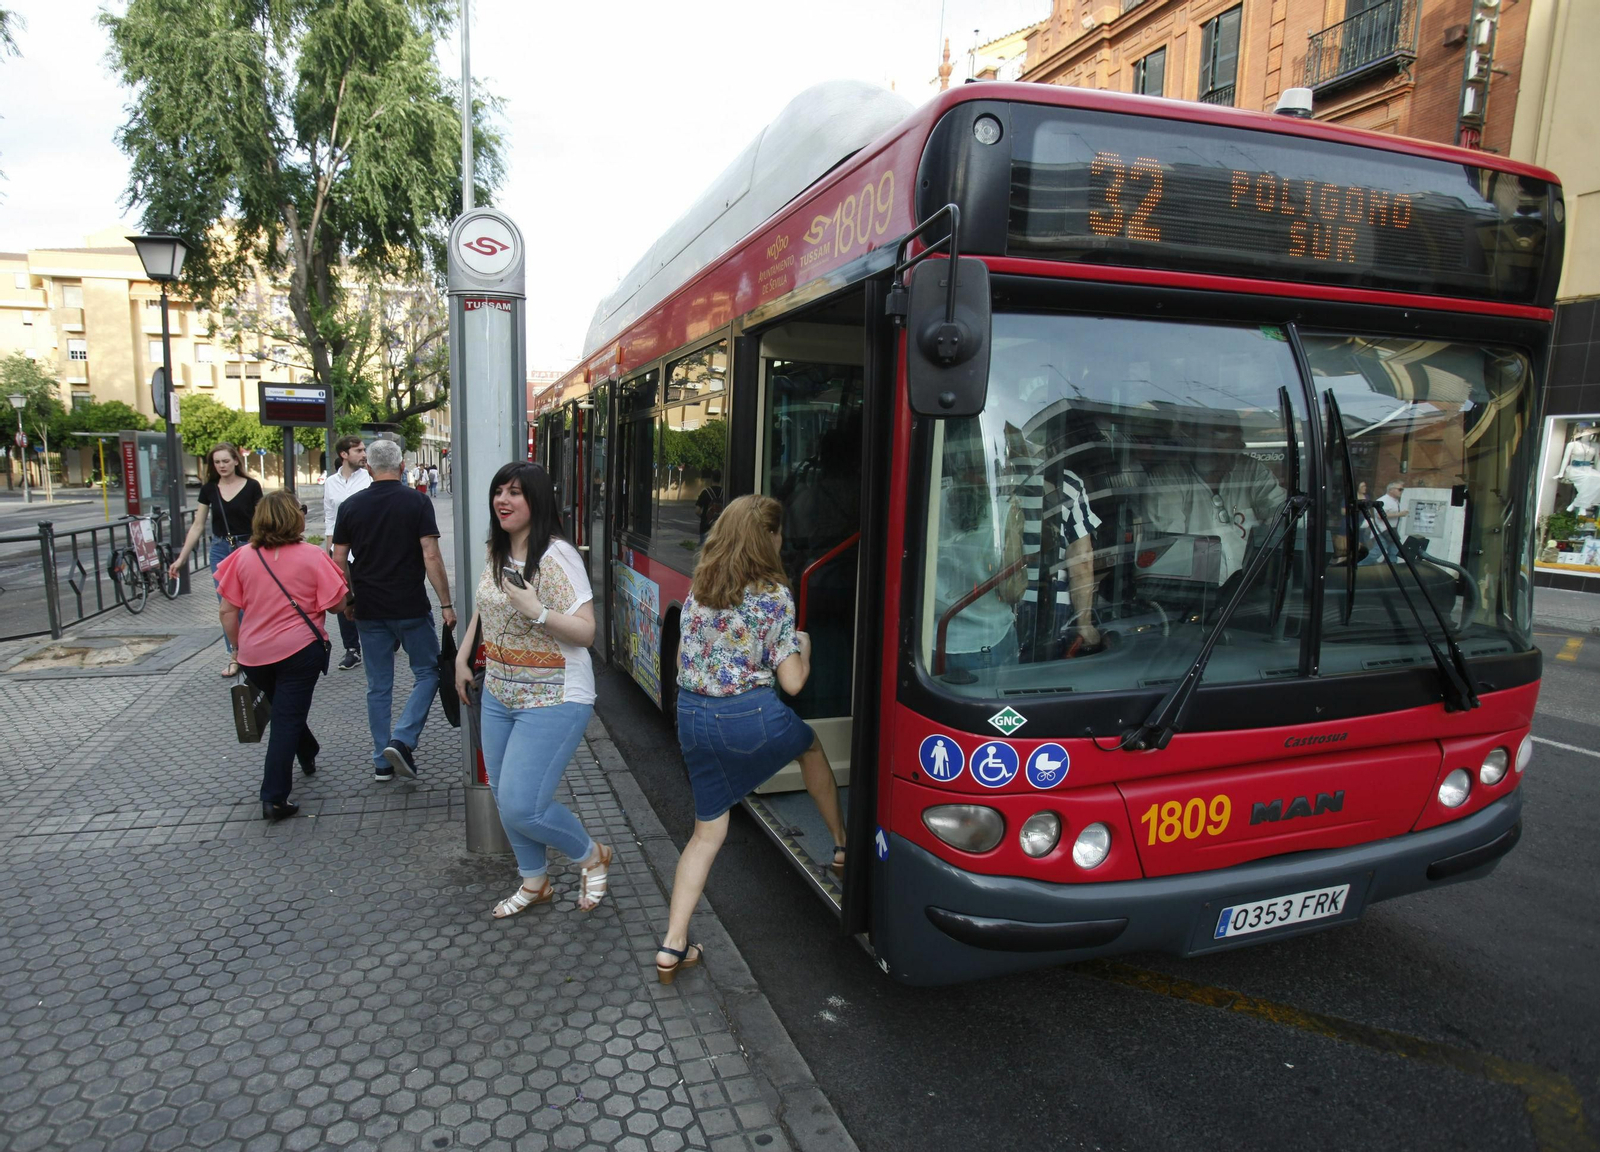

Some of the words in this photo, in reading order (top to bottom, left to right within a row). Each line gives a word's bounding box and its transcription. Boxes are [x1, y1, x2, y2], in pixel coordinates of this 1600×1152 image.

[1089, 152, 1163, 241] 32
[1231, 171, 1411, 228] POLIGONO
[833, 170, 895, 258] 1809
[800, 242, 831, 268] TUSSAM
[1289, 221, 1357, 263] SUR
[466, 301, 511, 310] TUSSAM
[762, 283, 769, 295] DE
[994, 716, 1020, 726] GNC
[1284, 732, 1348, 748] Castrosua
[1141, 794, 1232, 846] 1809
[1250, 790, 1345, 826] MAN
[1233, 900, 1293, 931] 0353
[1298, 889, 1345, 918] FRK
